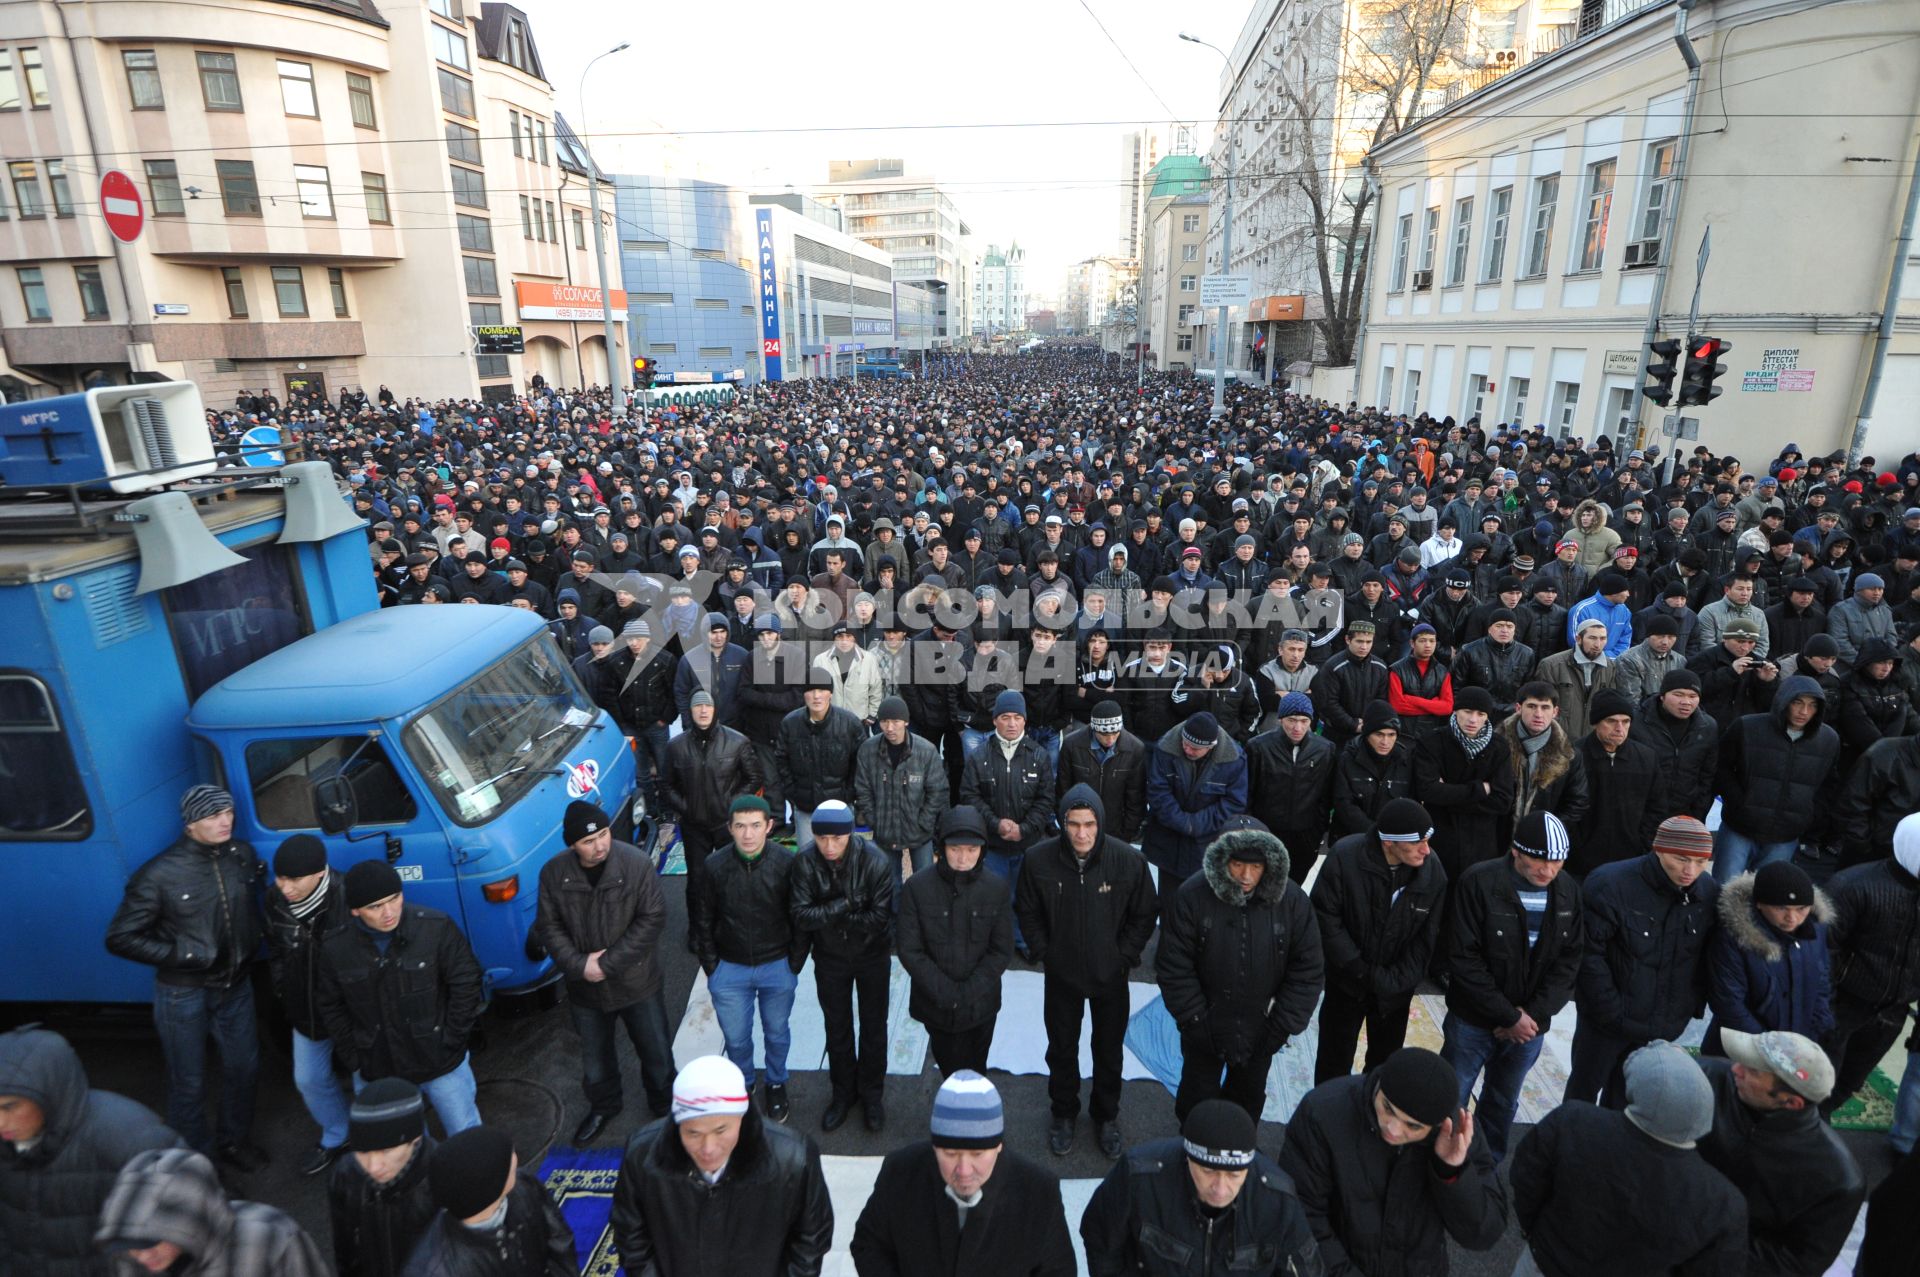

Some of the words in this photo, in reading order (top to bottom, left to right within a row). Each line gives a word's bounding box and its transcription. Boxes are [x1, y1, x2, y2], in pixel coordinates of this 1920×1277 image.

[760, 220, 775, 328] ПАРКИНГ
[563, 287, 602, 302] СОГЛАСИЕ
[479, 327, 520, 336] ЛОМБАРД
[764, 341, 779, 353] 24
[1763, 348, 1799, 357] ДИПЛОМ
[1609, 354, 1637, 364] ЩЕПКИНА
[1761, 363, 1797, 371] 517-02-15
[21, 411, 60, 425] МГРС
